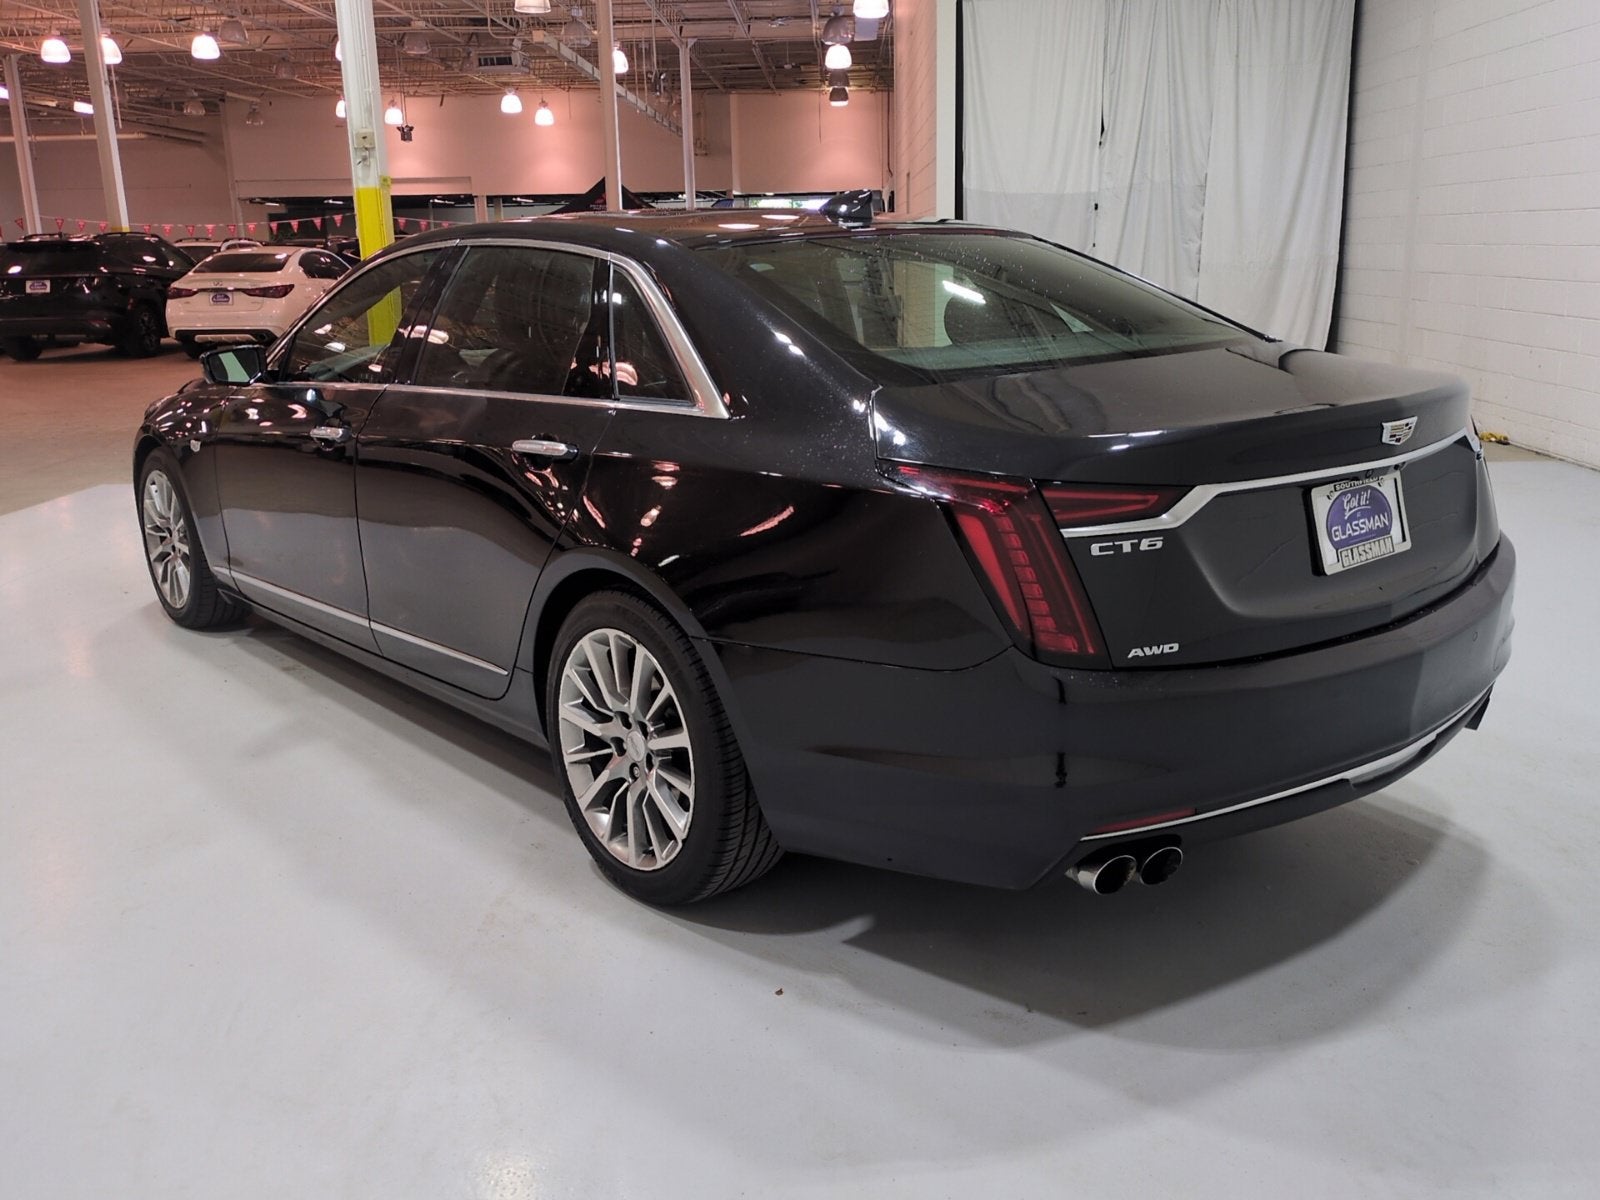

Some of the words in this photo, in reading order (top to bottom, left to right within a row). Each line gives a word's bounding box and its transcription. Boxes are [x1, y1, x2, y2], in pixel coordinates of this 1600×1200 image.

[1343, 493, 1359, 513] Got
[1360, 489, 1371, 506] it!
[1331, 512, 1389, 541] GLASSMAN
[1090, 536, 1164, 556] CT6
[1342, 537, 1393, 567] GLASSMAN
[1127, 642, 1179, 659] AWD
